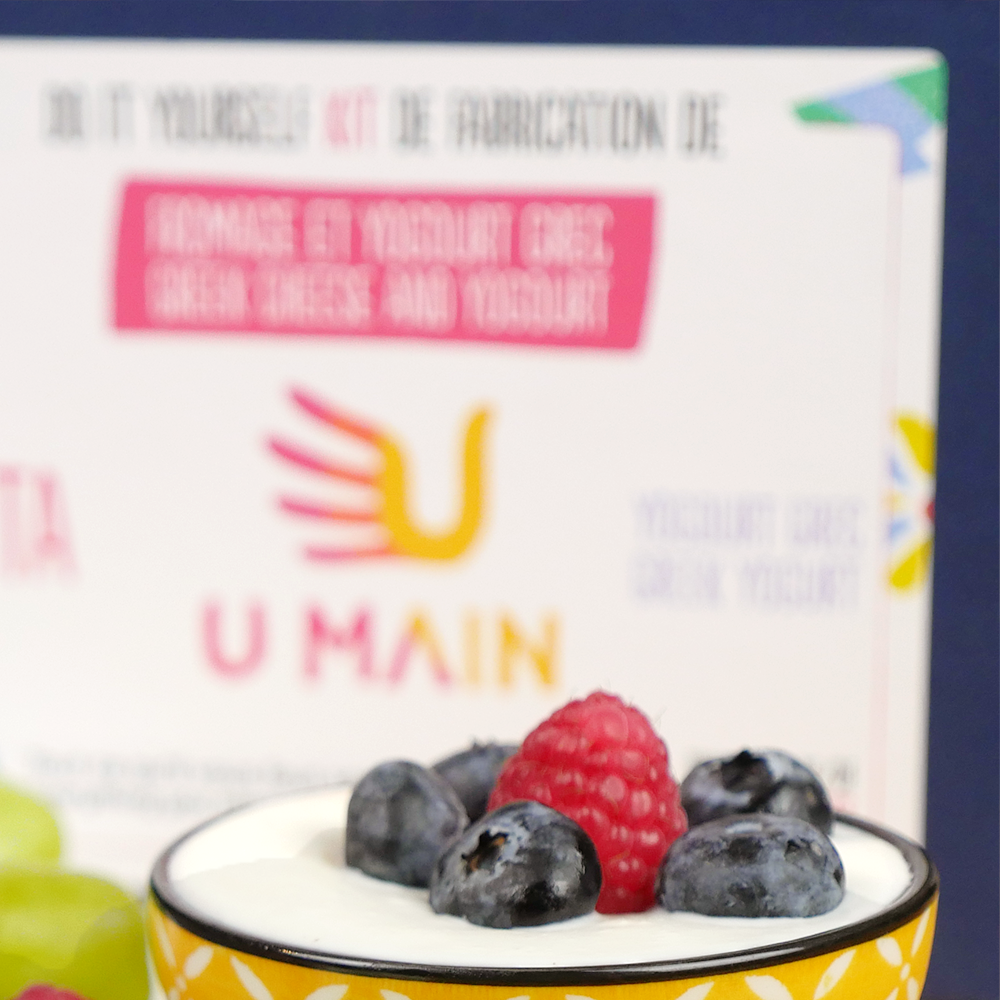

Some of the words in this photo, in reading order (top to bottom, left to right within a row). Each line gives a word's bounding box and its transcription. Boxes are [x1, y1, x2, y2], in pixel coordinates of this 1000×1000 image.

[450, 88, 662, 154] FABRICATION
[680, 91, 723, 157] DE
[302, 196, 352, 257] ET
[377, 263, 456, 332] AND
[199, 596, 266, 683] U
[301, 600, 561, 688] MAIN
